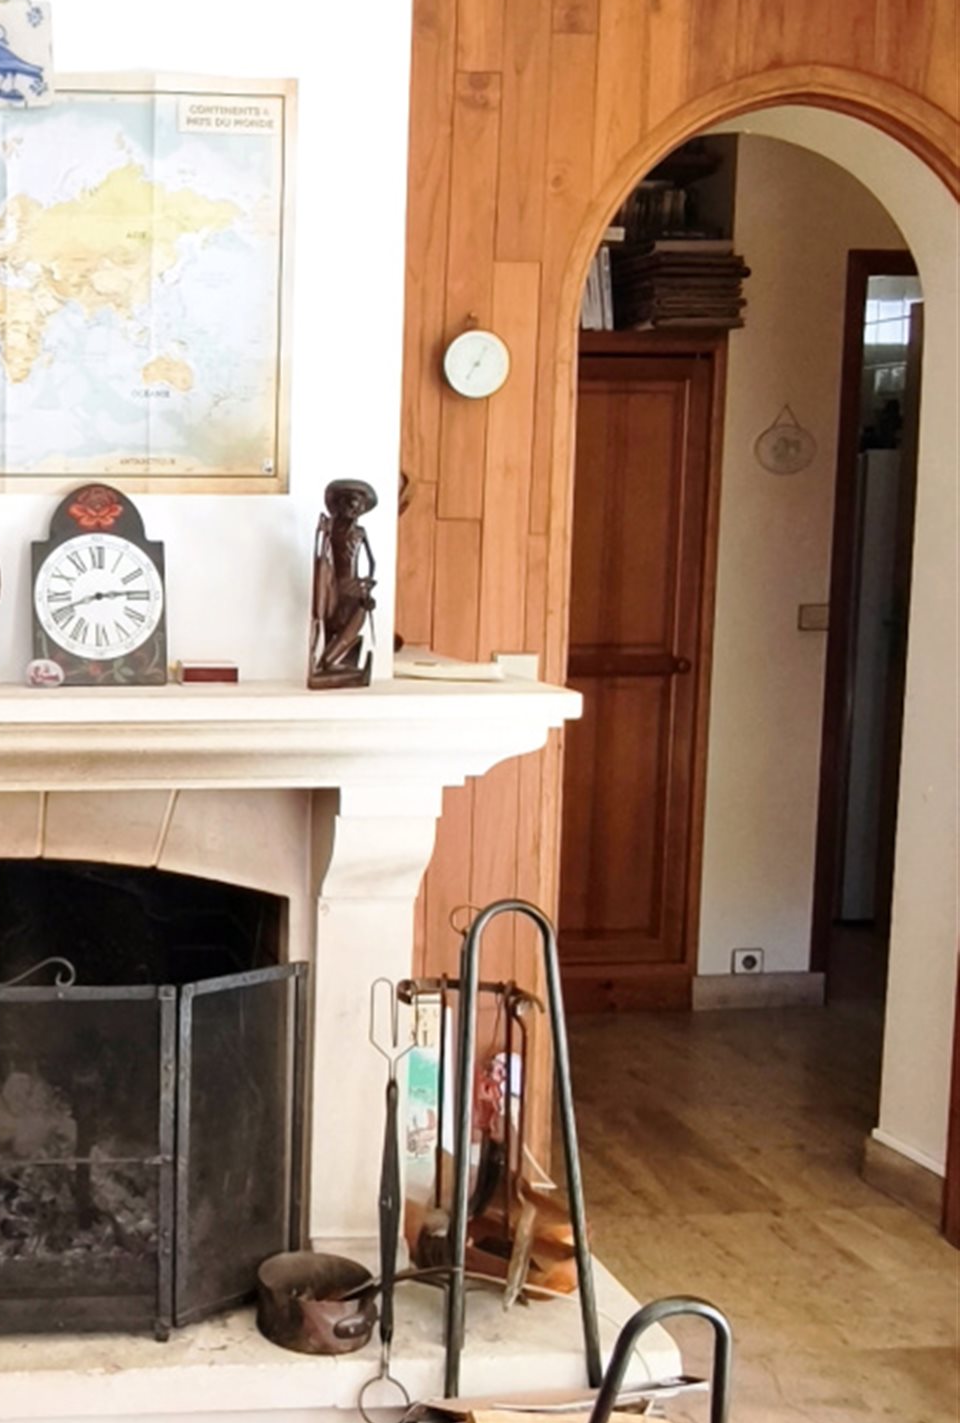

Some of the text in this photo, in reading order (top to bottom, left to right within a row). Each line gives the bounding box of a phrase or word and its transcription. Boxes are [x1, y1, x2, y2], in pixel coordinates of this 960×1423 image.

[188, 104, 260, 116] CONTINENTS
[215, 117, 231, 127] DU
[233, 118, 274, 129] MONDE
